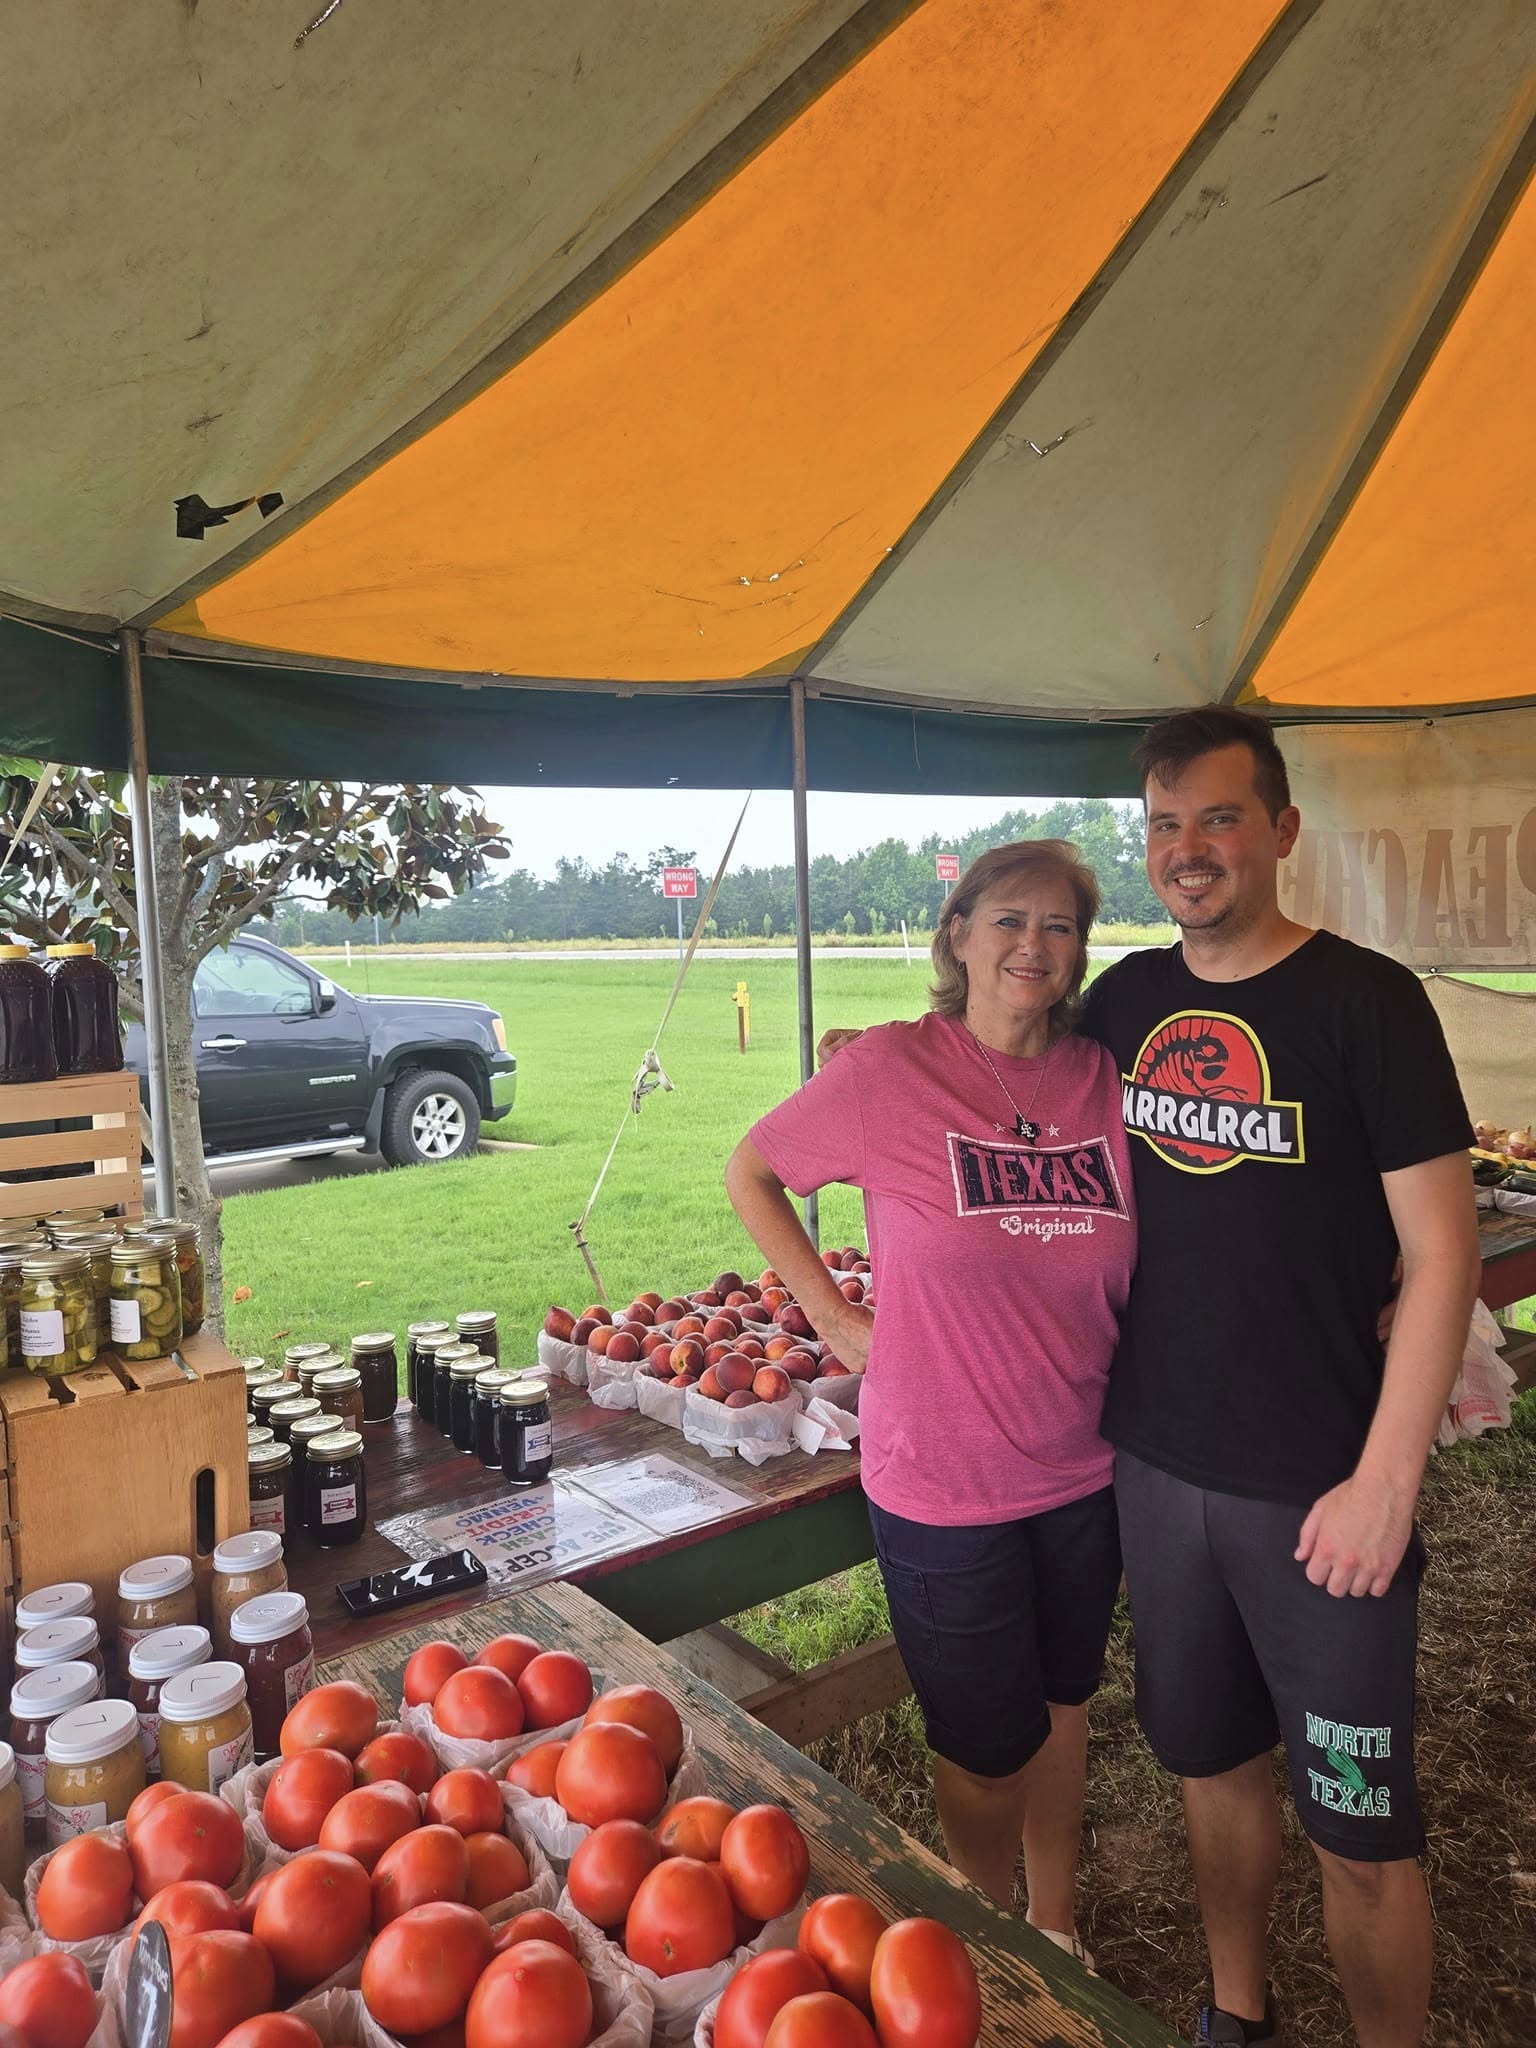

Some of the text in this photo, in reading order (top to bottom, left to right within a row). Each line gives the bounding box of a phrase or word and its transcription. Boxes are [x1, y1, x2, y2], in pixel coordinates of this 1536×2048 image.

[938, 858, 957, 867] WRONG
[941, 868, 954, 877] WAY
[665, 871, 694, 882] WRONG
[670, 883, 689, 893] WAY
[308, 1074, 357, 1086] SIERRA
[968, 1146, 1106, 1205] TEXAS
[999, 1214, 1097, 1243] Original
[456, 1498, 538, 1528] VENMO
[466, 1505, 548, 1538] CREDIT
[476, 1515, 556, 1546] CHECK
[499, 1526, 564, 1552] CASH
[581, 1520, 627, 1544] WE
[1305, 1711, 1392, 1759] NORTH
[1307, 1767, 1392, 1817] TEXAS
